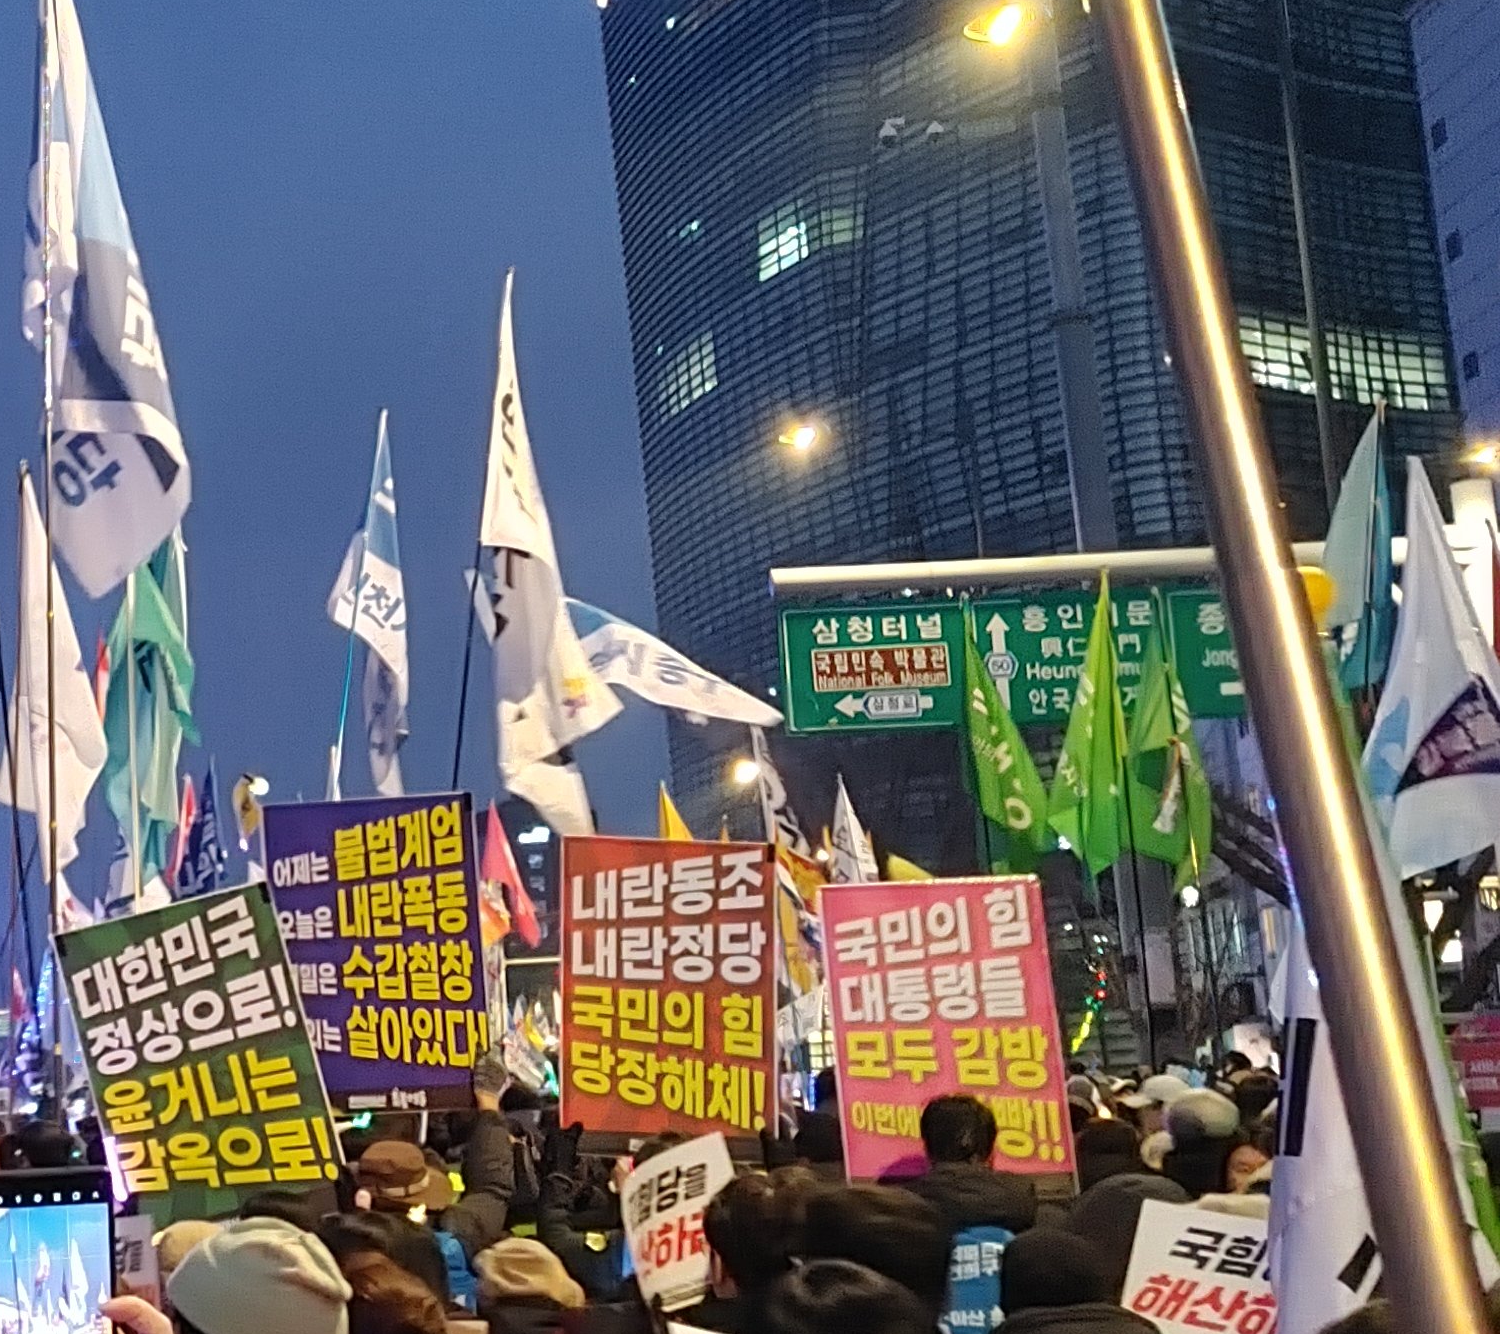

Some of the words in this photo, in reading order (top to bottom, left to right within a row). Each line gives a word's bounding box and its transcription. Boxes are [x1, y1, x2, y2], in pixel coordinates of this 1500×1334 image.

[812, 612, 943, 645] 삼청터널
[1041, 633, 1141, 658] 興仁門
[273, 851, 330, 888] 어제는
[335, 802, 463, 881] 불법계엄
[278, 905, 334, 940] 오늘은
[337, 870, 469, 940] 내란폭동
[571, 849, 765, 923] 내란동조
[70, 895, 261, 1021] 대한민국
[571, 920, 767, 984] 내란정당
[833, 896, 971, 967] 국민의
[983, 884, 1032, 950] 힘
[342, 939, 474, 1003] 수갑철창
[840, 956, 1028, 1026] 대통령들
[87, 967, 298, 1077] 정상으로!
[346, 1006, 489, 1068] 살아있다!
[571, 985, 705, 1051] 국민의
[722, 991, 764, 1059] 힘
[103, 1049, 302, 1135] 윤거니는
[570, 1041, 767, 1131] 당장해체!
[845, 1027, 939, 1084] 모두
[951, 1025, 1050, 1091] 감방
[115, 1116, 339, 1194] 감옥으로!
[978, 1094, 1067, 1164] 빵!!
[1169, 1225, 1271, 1282] 국힘
